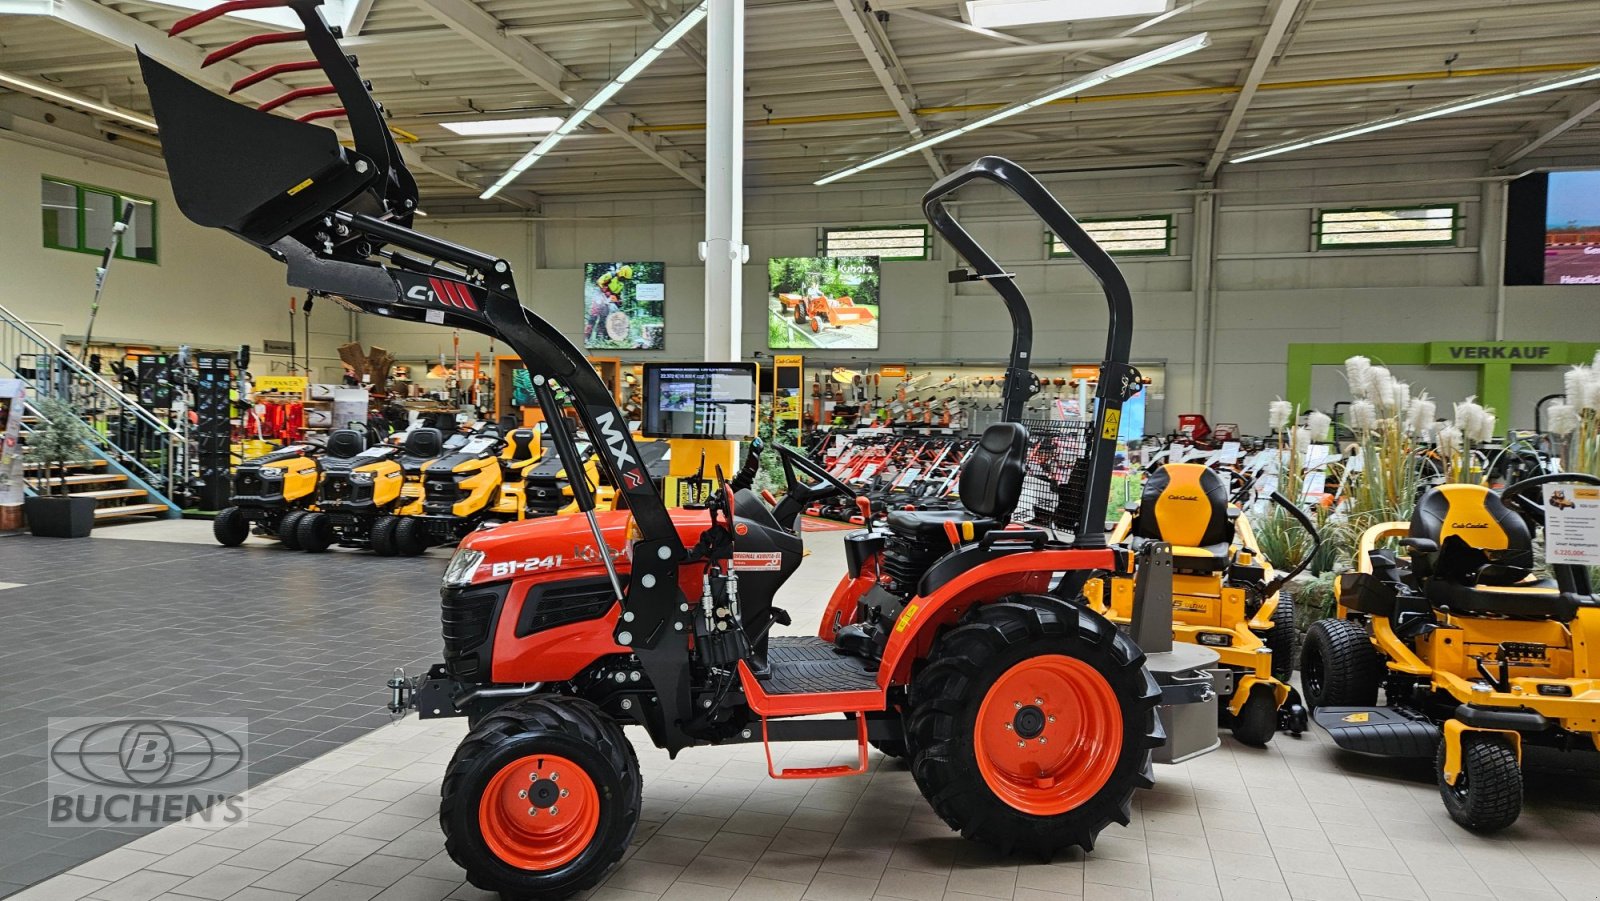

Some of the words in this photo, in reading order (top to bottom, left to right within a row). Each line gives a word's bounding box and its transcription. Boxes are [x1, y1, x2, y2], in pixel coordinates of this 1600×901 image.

[838, 264, 874, 274] Kubota
[407, 285, 434, 301] C1
[1449, 346, 1550, 359] VERKAUF
[595, 411, 637, 471] MX
[492, 554, 563, 578] B1-241
